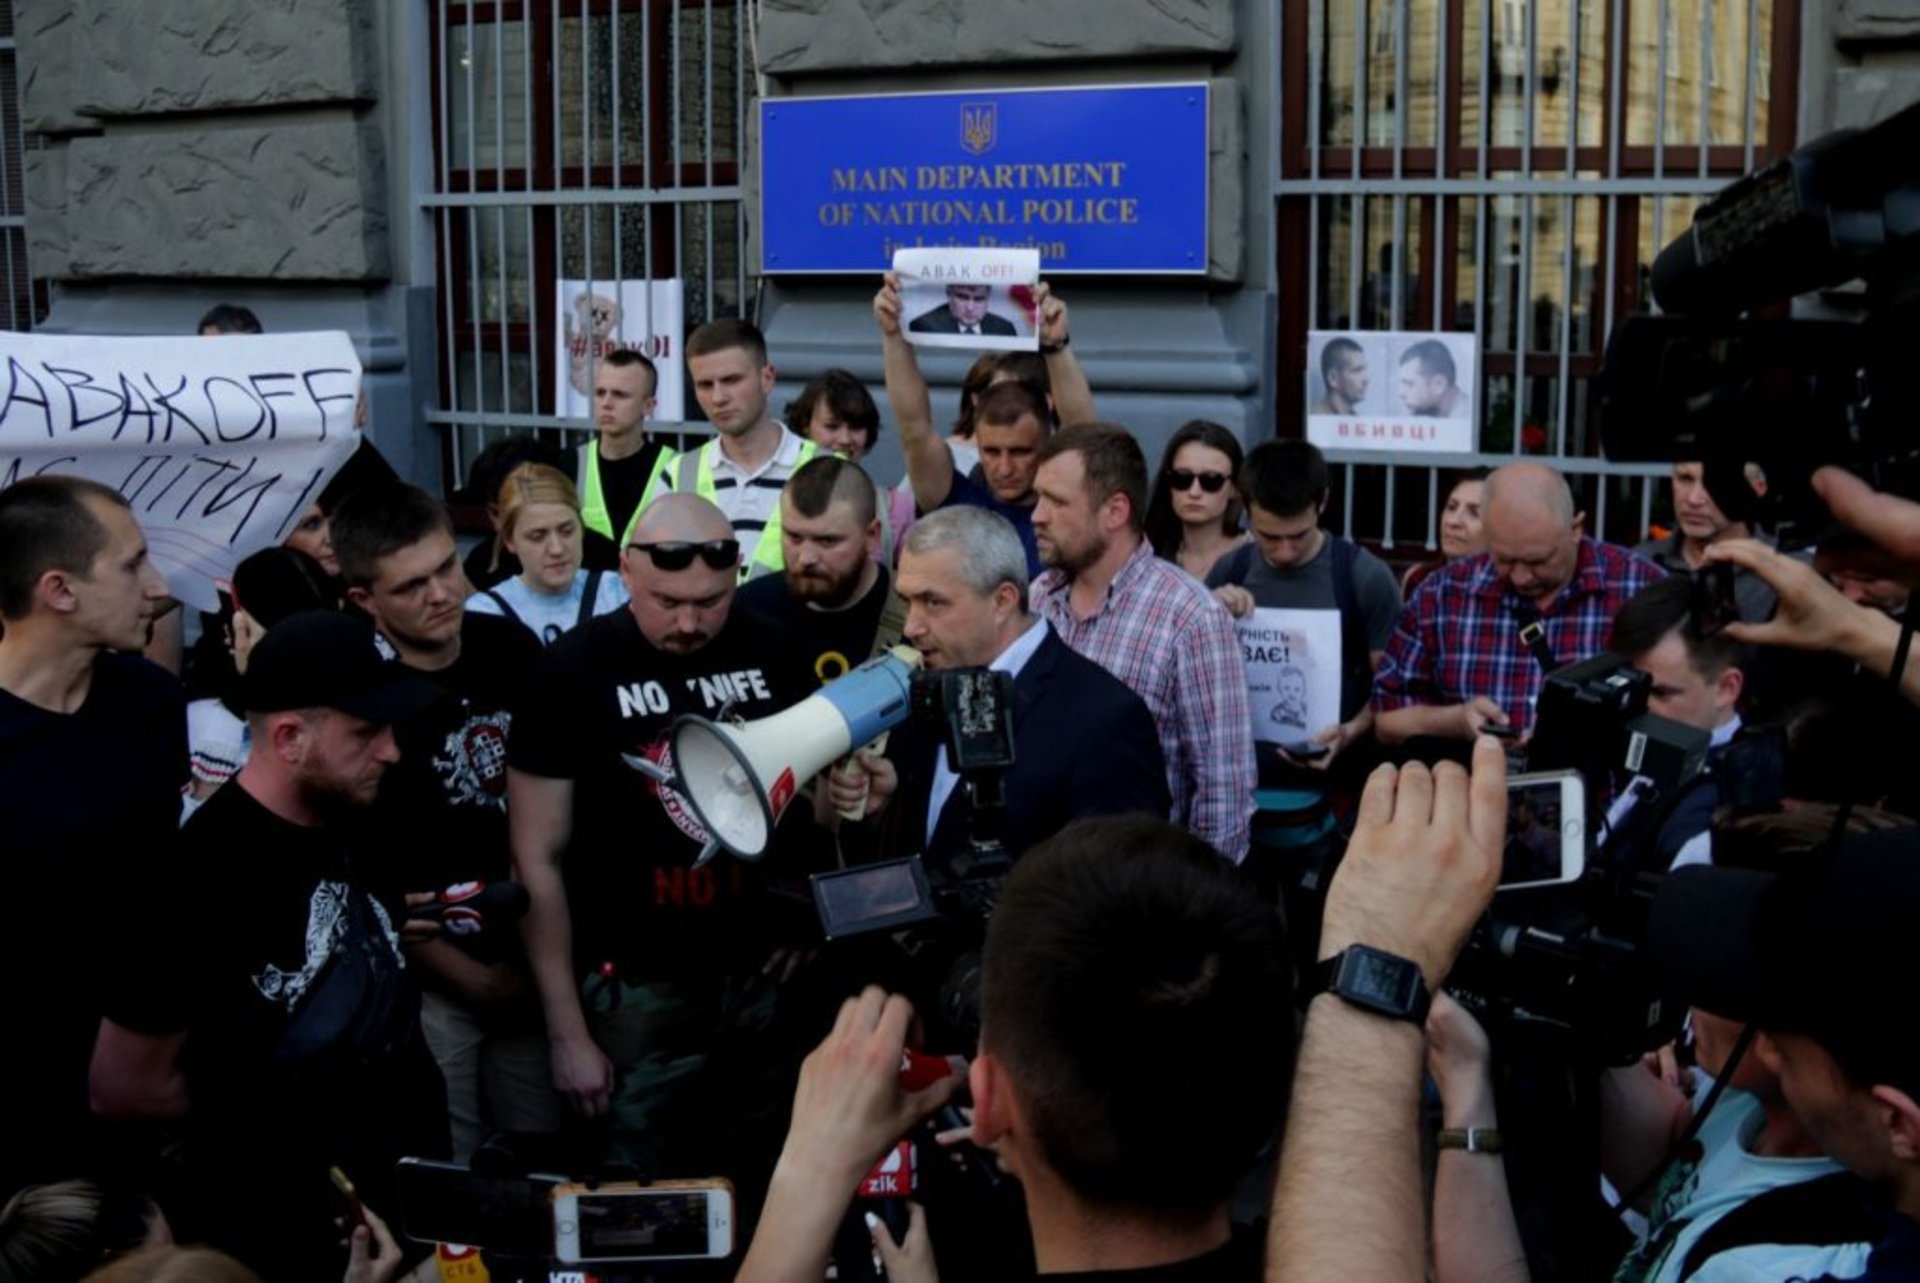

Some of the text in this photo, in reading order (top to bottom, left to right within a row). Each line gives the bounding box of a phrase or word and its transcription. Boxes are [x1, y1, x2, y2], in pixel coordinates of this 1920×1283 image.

[832, 162, 1127, 192] MAIN DEPARTMENT
[818, 198, 1139, 227] OF NATIONAL POLICE
[1338, 423, 1435, 440] ВБИВЦІ
[616, 668, 772, 719] NO NIFE
[655, 866, 714, 906] NO
[868, 1175, 898, 1194] zik
